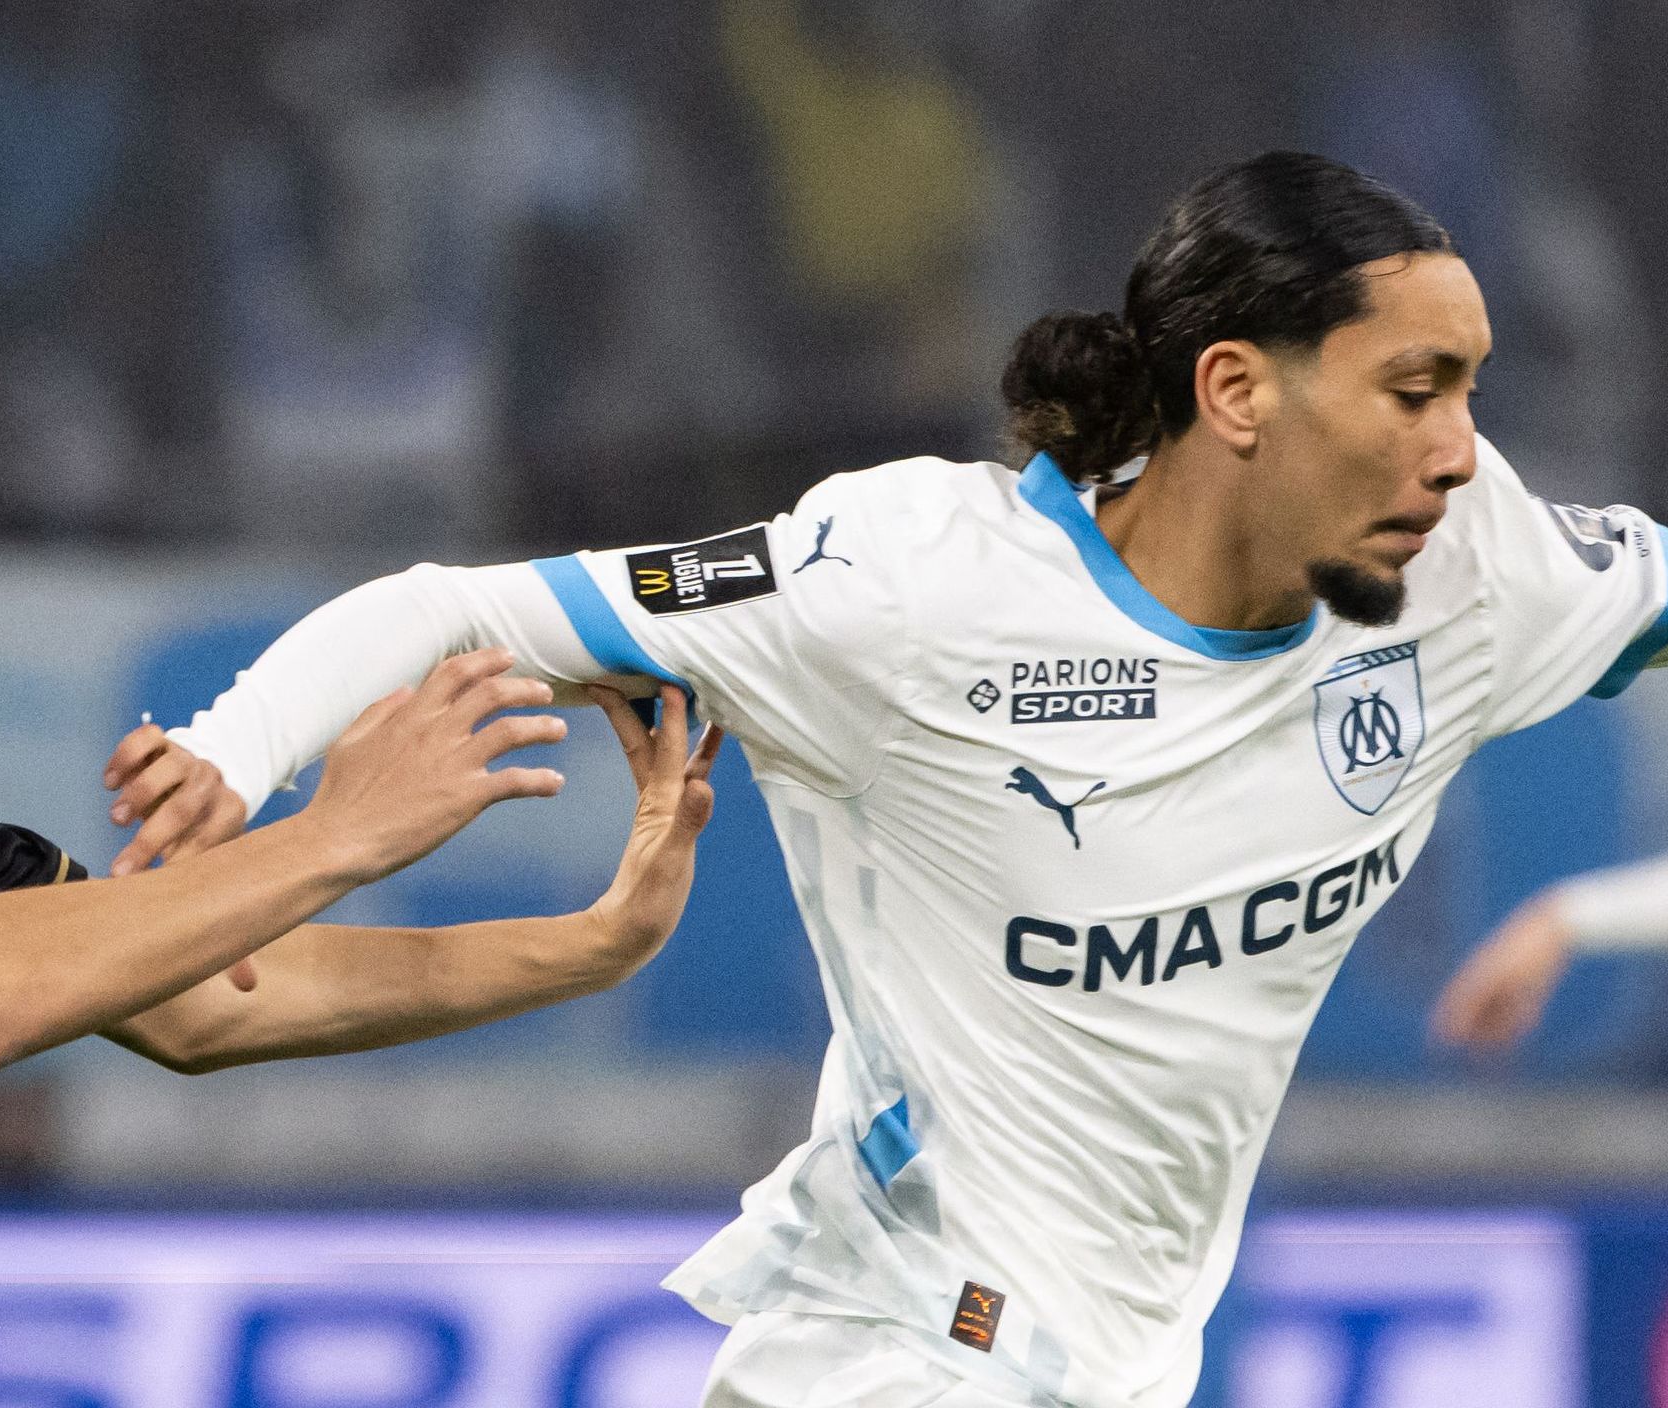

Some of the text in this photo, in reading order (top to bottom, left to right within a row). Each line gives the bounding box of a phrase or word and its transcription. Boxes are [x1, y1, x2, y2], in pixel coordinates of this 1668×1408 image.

[1012, 658, 1160, 688] PARIONS
[1015, 693, 1153, 720] SPORT
[1005, 832, 1402, 992] CMA CGM
